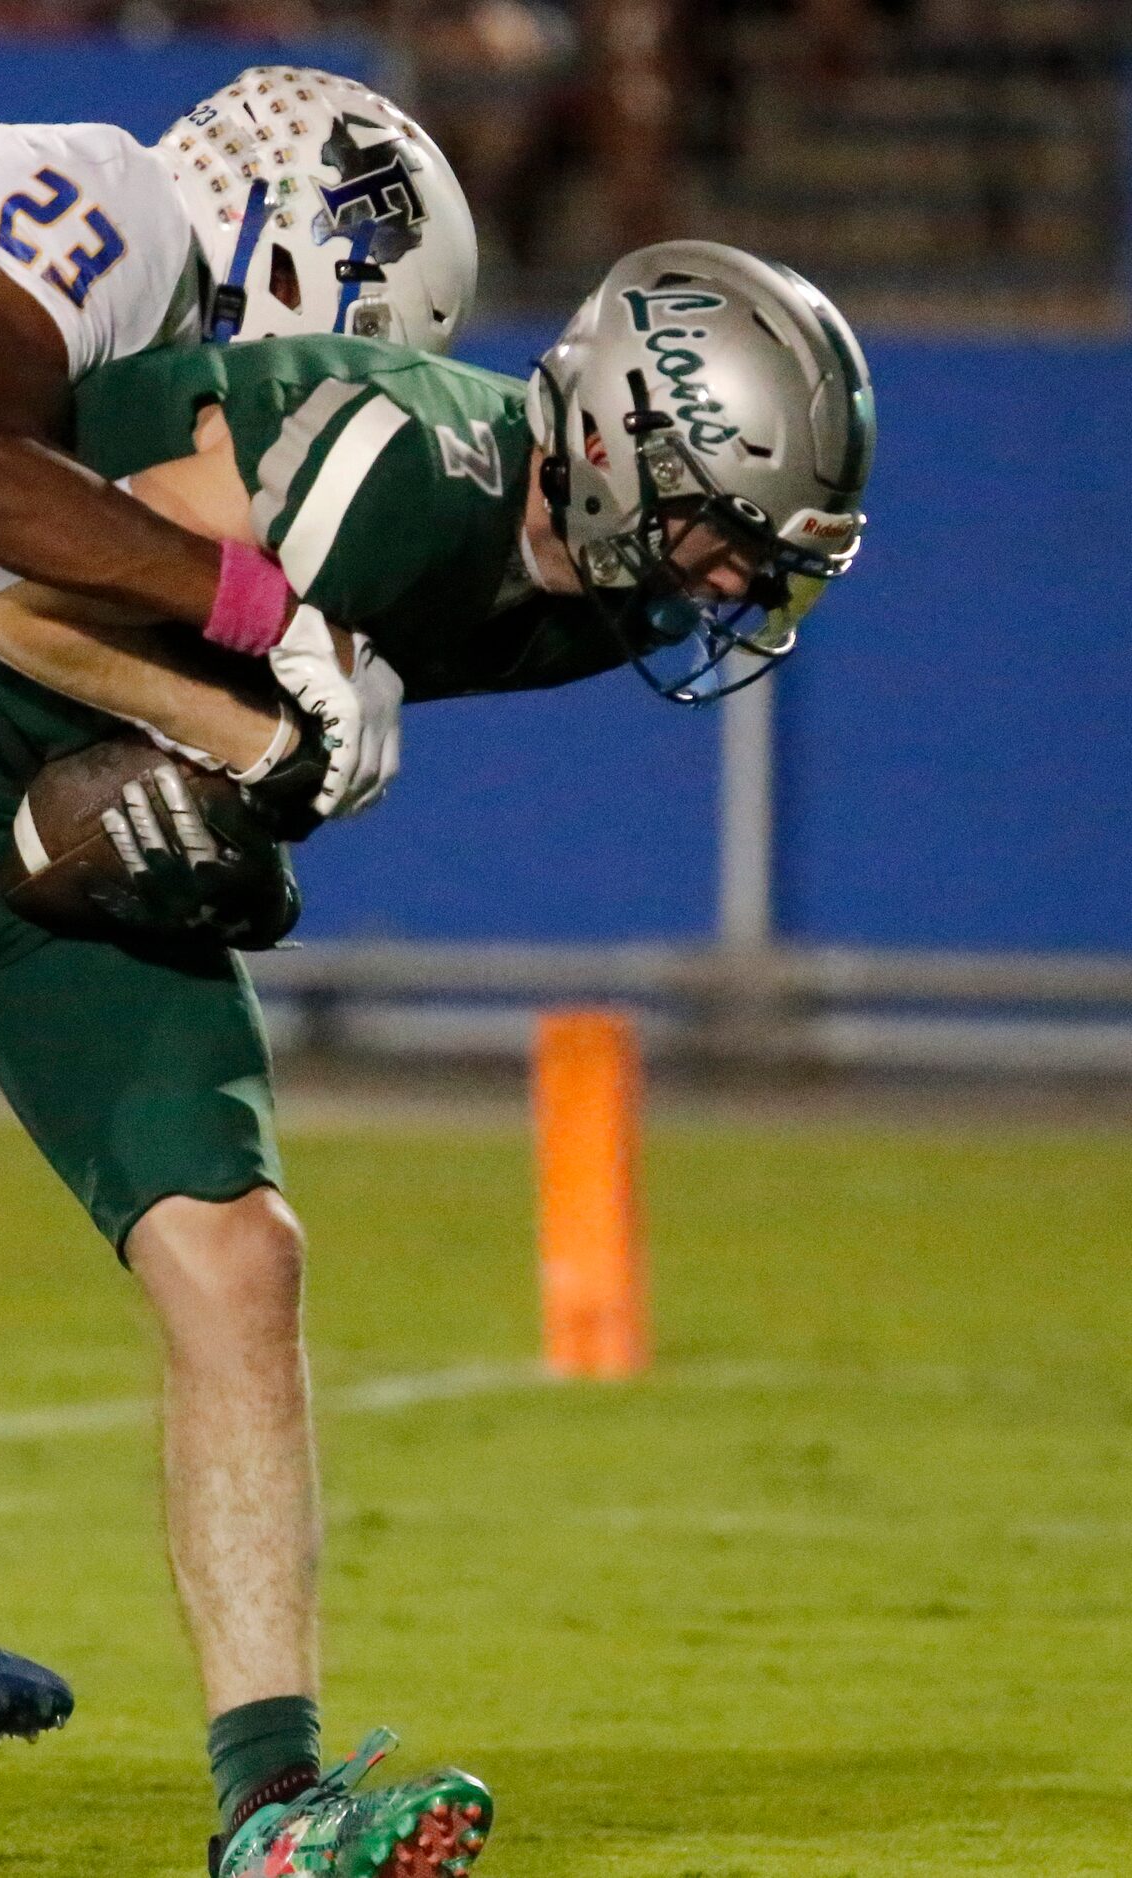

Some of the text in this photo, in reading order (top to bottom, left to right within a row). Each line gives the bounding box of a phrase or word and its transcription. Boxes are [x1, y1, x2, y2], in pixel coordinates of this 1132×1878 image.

[188, 105, 218, 126] 23
[621, 287, 741, 457] Lions
[435, 418, 504, 497] 7
